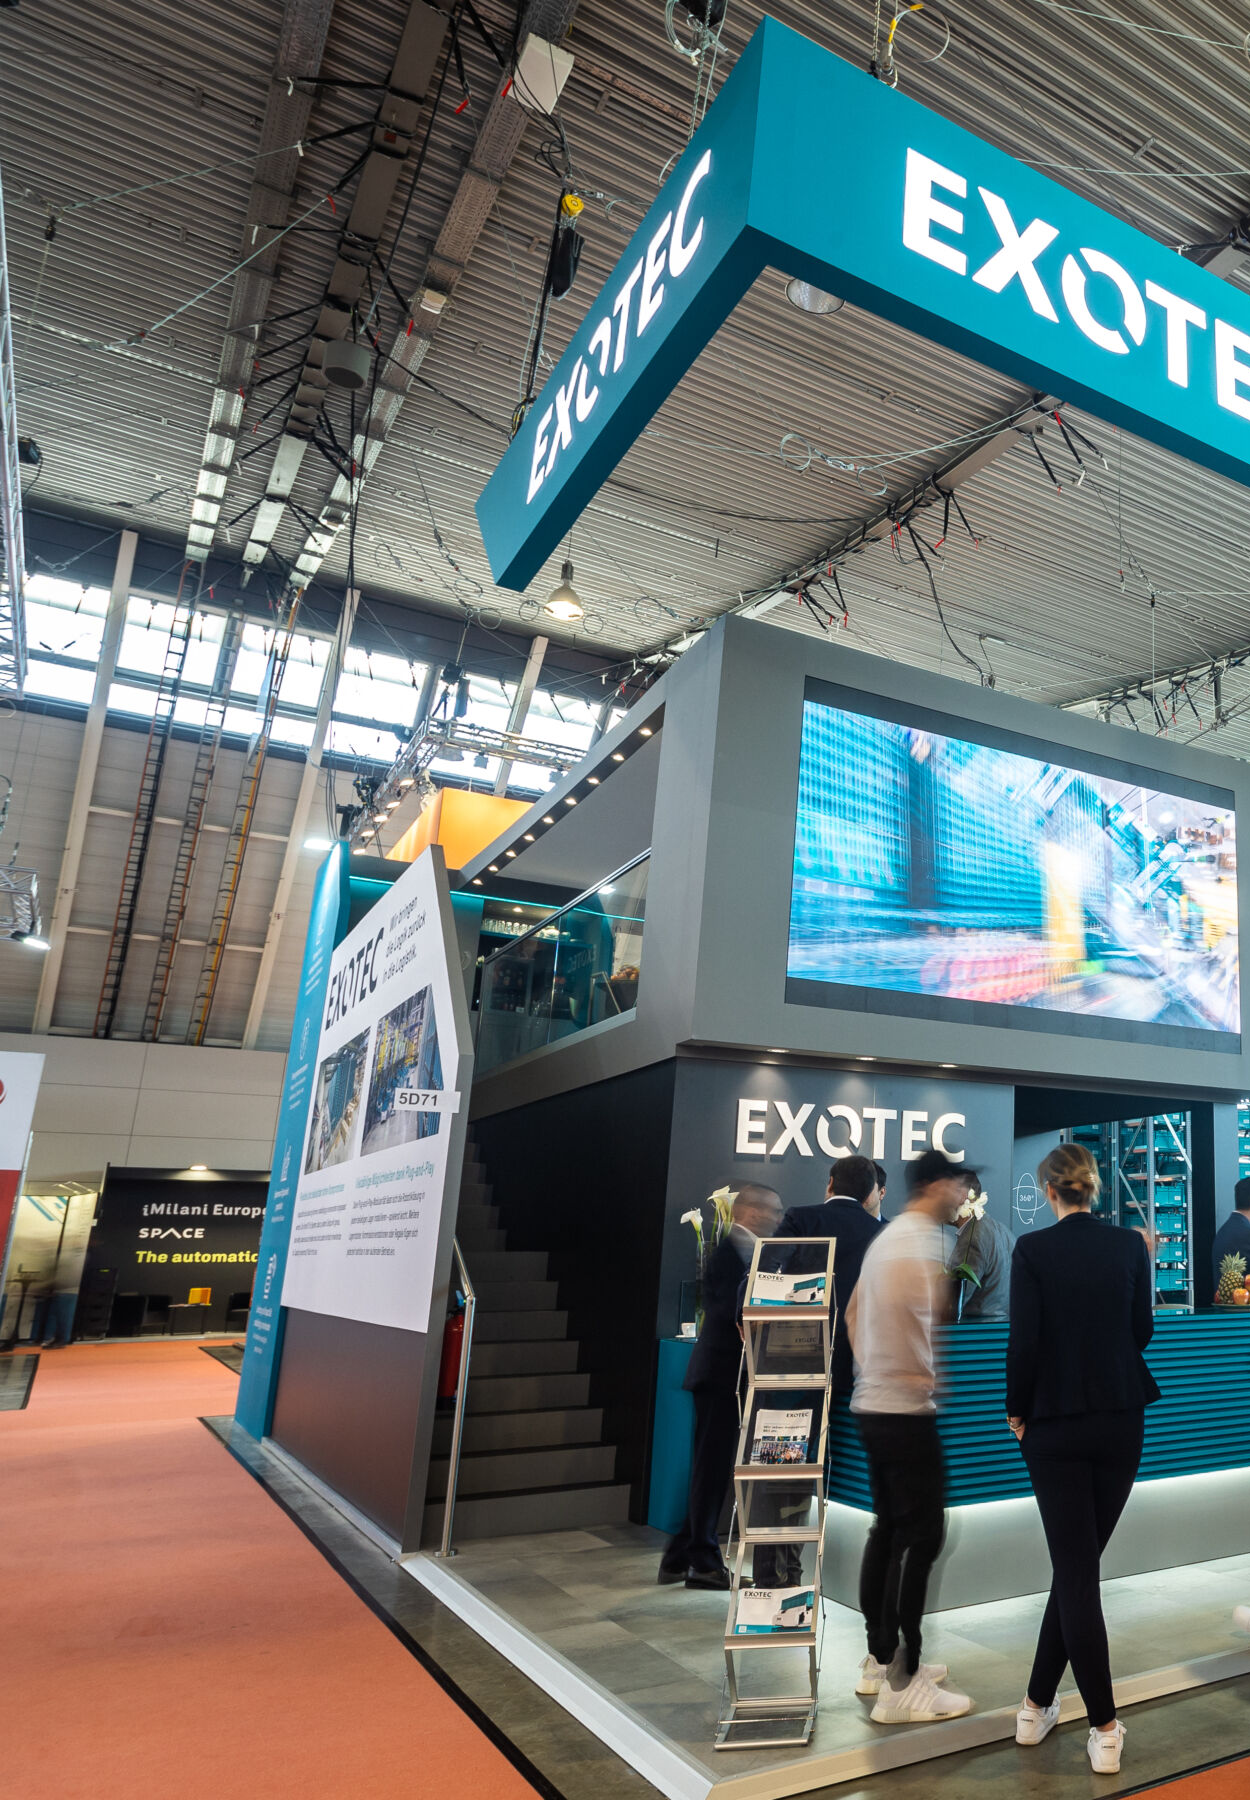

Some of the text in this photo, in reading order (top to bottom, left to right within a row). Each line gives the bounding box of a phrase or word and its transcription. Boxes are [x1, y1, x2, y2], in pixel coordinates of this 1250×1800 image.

[526, 149, 711, 504] EXOTEC
[398, 896, 418, 924] bringen
[325, 927, 384, 1031] EXOTEC
[399, 1092, 438, 1106] 5D71
[735, 1098, 966, 1163] EXOTEC
[143, 1203, 208, 1216] iMilani
[136, 1251, 168, 1263] The
